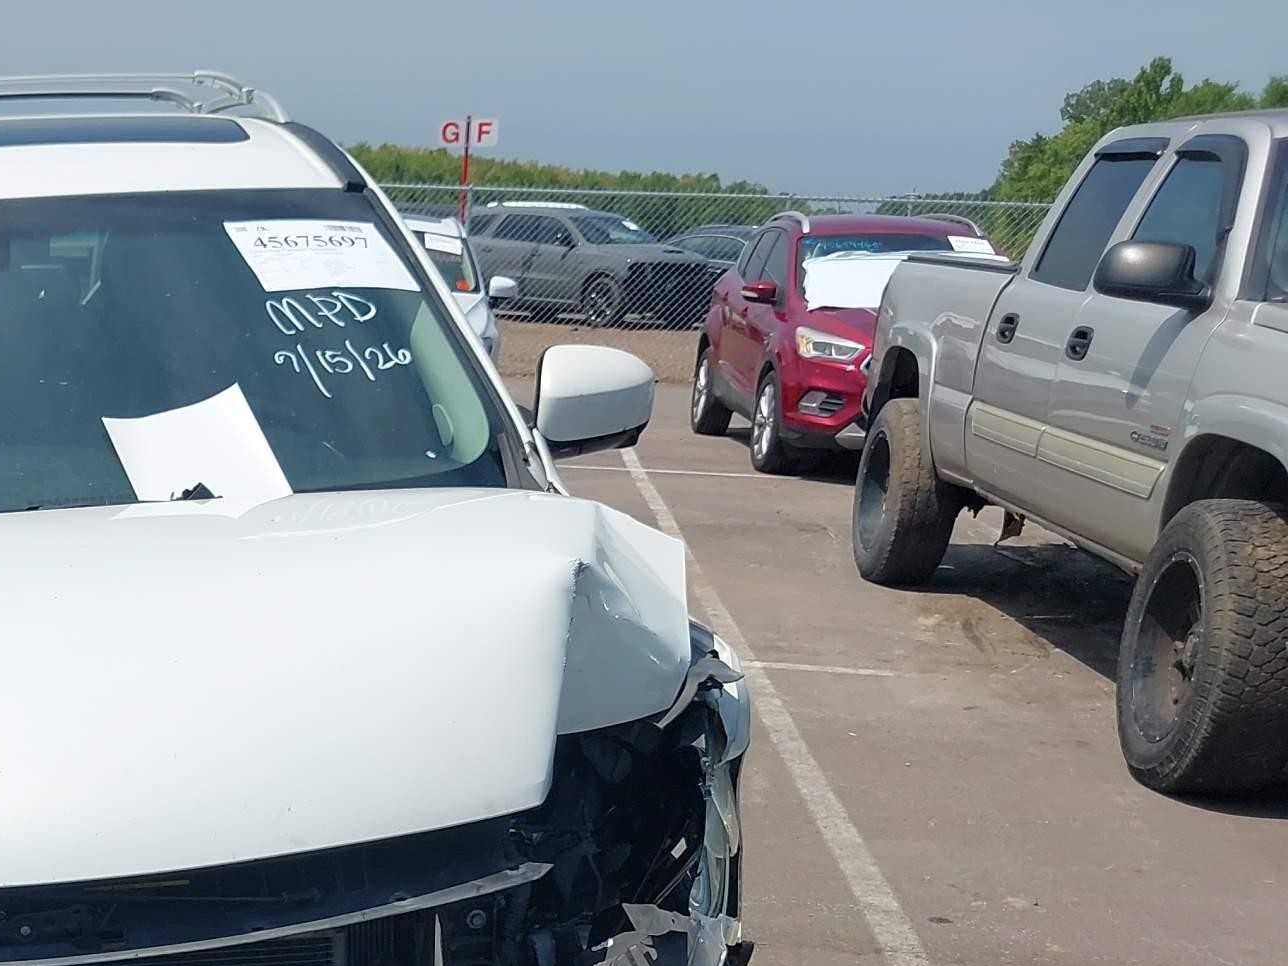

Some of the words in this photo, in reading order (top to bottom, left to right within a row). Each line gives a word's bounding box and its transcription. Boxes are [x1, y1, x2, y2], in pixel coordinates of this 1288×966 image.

[442, 122, 460, 143] G
[476, 122, 493, 143] F
[254, 236, 368, 248] 45675697
[266, 292, 377, 335] MPD
